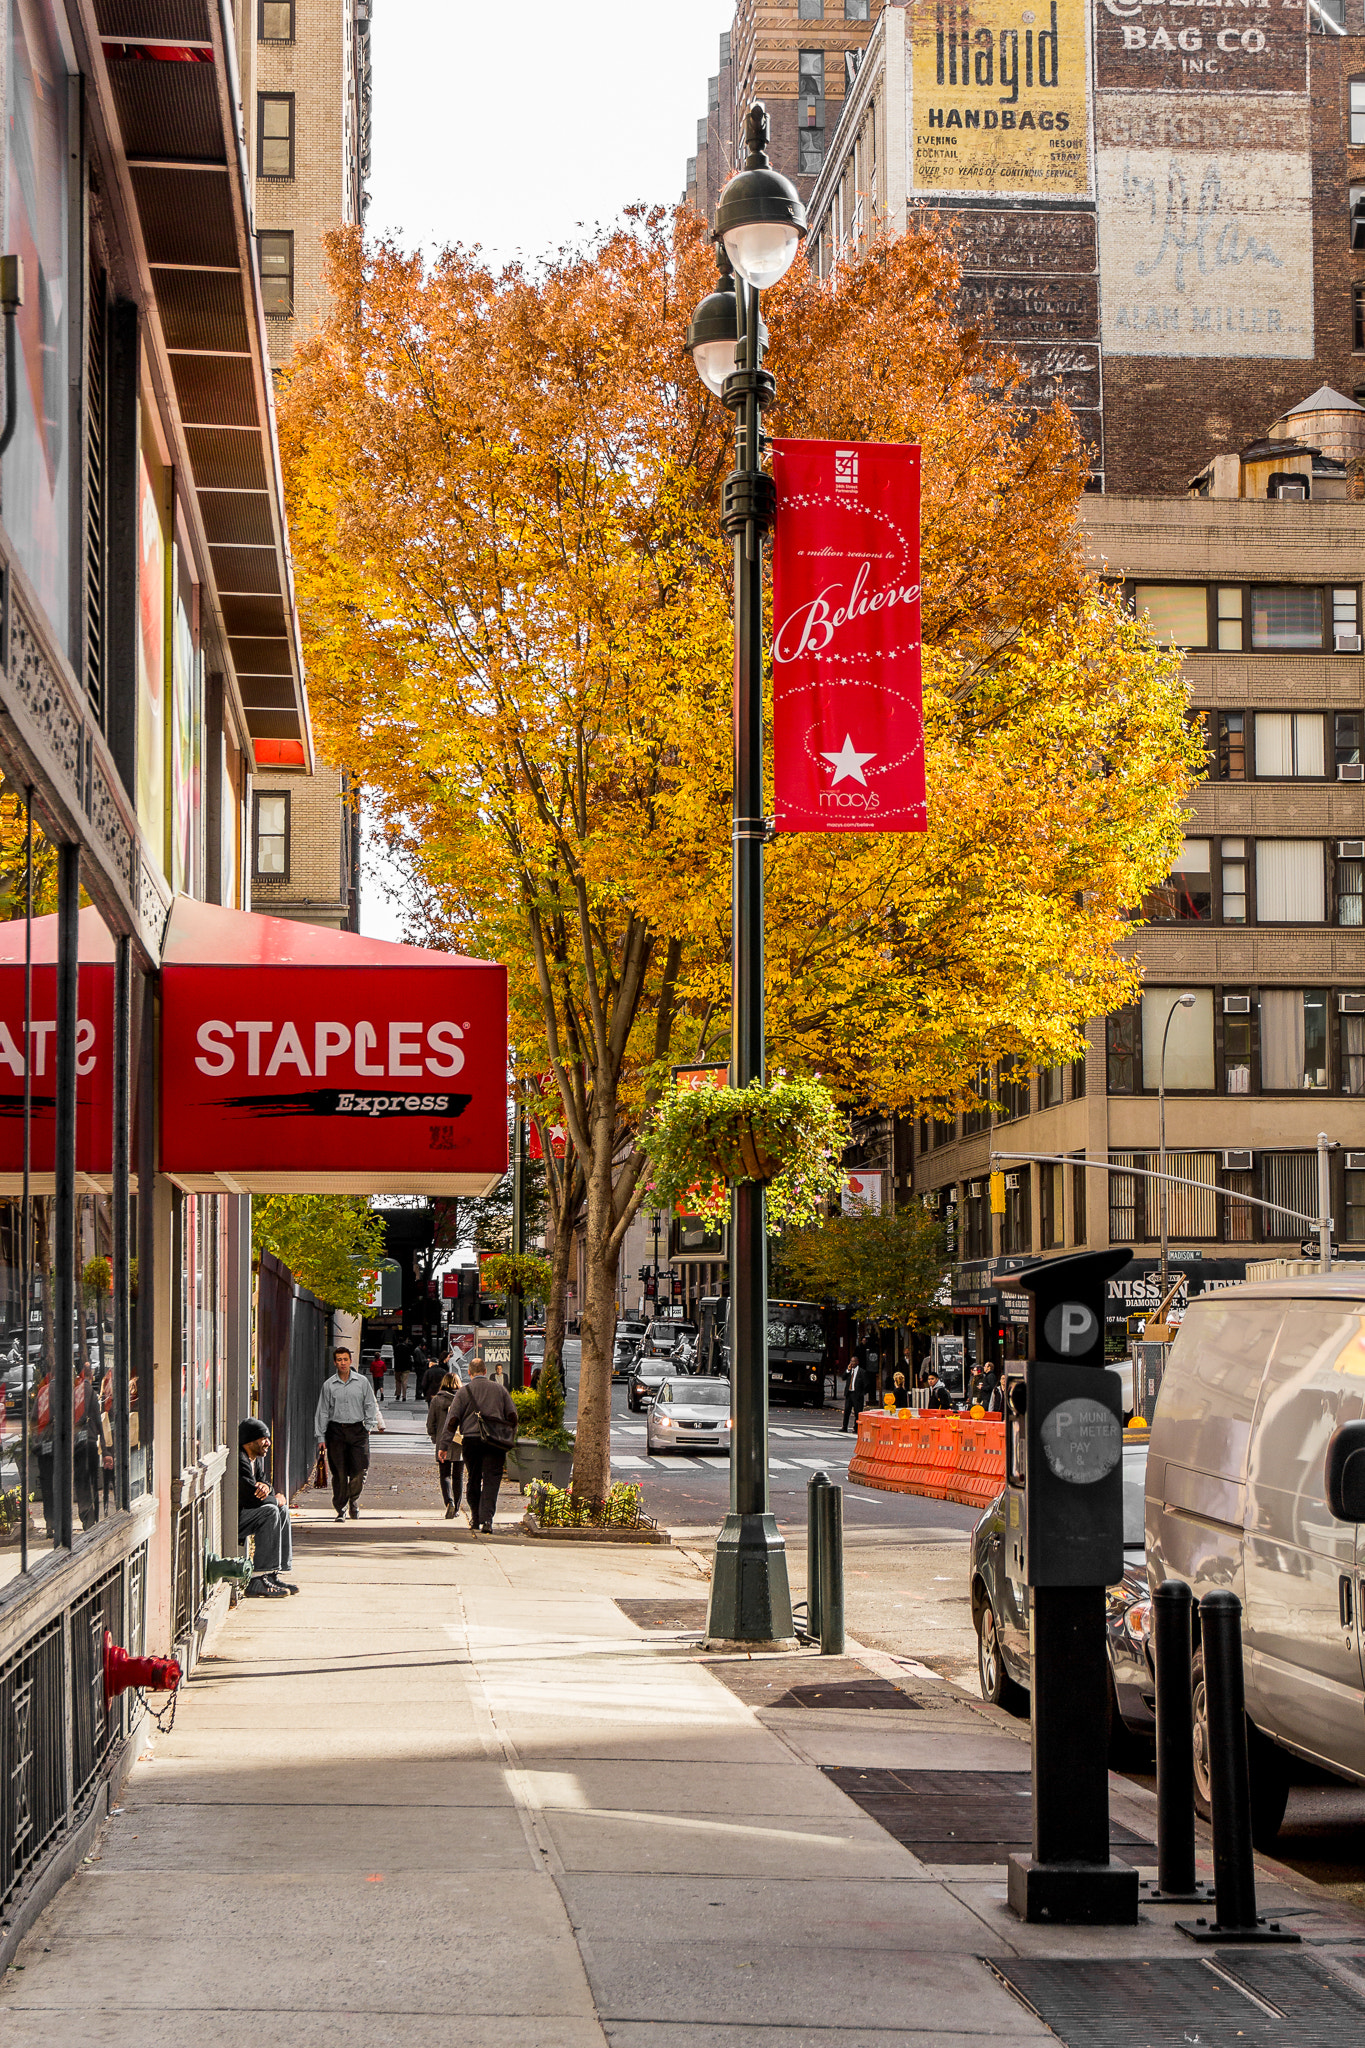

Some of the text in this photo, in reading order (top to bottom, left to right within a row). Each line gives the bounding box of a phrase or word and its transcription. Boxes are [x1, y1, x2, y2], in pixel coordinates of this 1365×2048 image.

[1121, 26, 1271, 52] BAG CO.
[1181, 59, 1225, 74] INC.
[928, 108, 1070, 131] HANDBAGS
[917, 136, 958, 145] EVENING
[916, 150, 959, 159] COCKTAIL
[918, 166, 940, 176] OVER
[958, 167, 984, 177] YEARS
[986, 168, 997, 177] OF
[1114, 306, 1179, 330] ALAN
[1192, 307, 1282, 333] MILLER
[807, 546, 843, 557] million
[847, 550, 883, 559] reasons
[885, 551, 895, 559] to
[774, 561, 921, 663] Believe
[335, 1093, 449, 1116] Express
[1169, 1251, 1194, 1260] MADISON
[1107, 1280, 1190, 1299] NISSN
[1125, 1299, 1161, 1307] DIAMOND
[1060, 1304, 1092, 1353] P
[484, 1353, 511, 1362] MAN
[1055, 1412, 1107, 1438] P MUNI
[1079, 1425, 1118, 1438] METER
[1070, 1442, 1091, 1453] PAY
[1076, 1454, 1085, 1466] &
